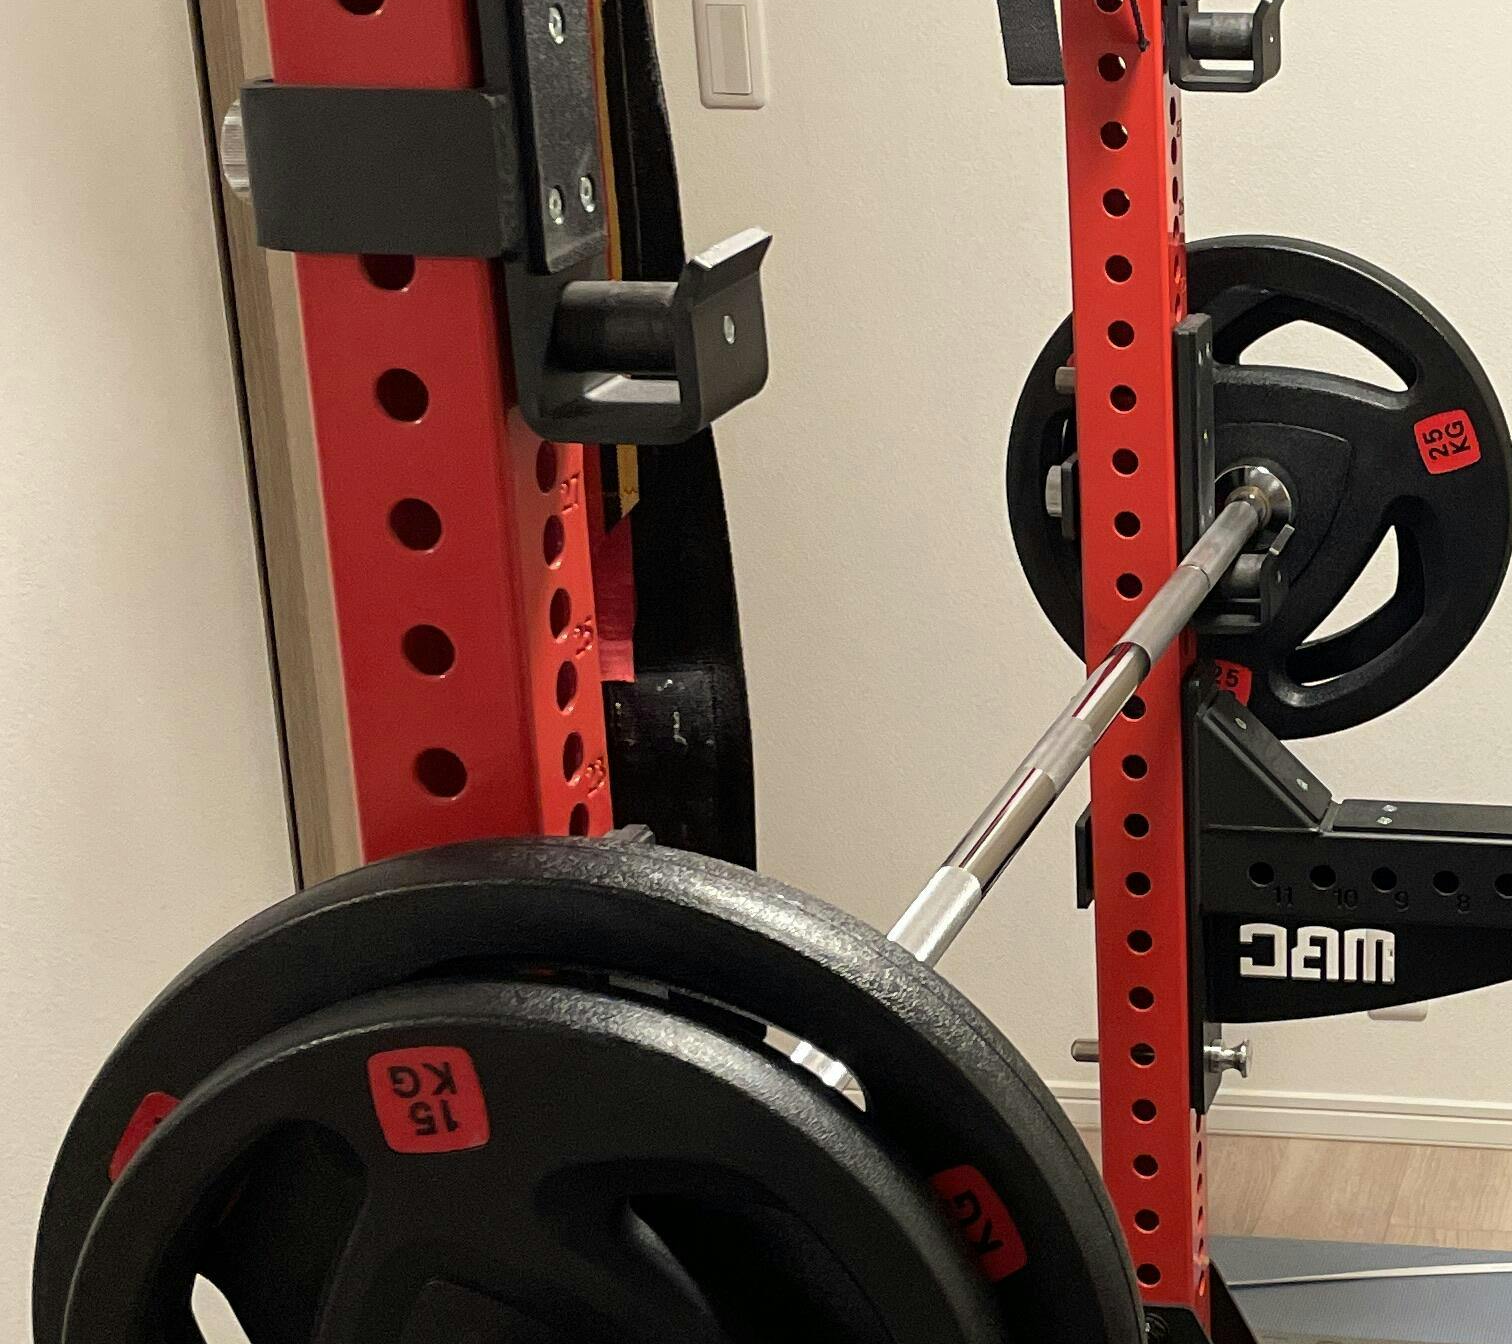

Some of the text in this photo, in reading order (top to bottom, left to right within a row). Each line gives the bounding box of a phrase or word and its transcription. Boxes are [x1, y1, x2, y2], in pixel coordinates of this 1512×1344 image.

[1421, 428, 1450, 461] 25
[1444, 420, 1472, 455] KG
[1272, 885, 1293, 907] 11
[1333, 887, 1359, 911] 10
[1394, 890, 1409, 913] 9
[1457, 893, 1472, 915] 8
[386, 1061, 458, 1099] KG
[408, 1099, 459, 1136] 15
